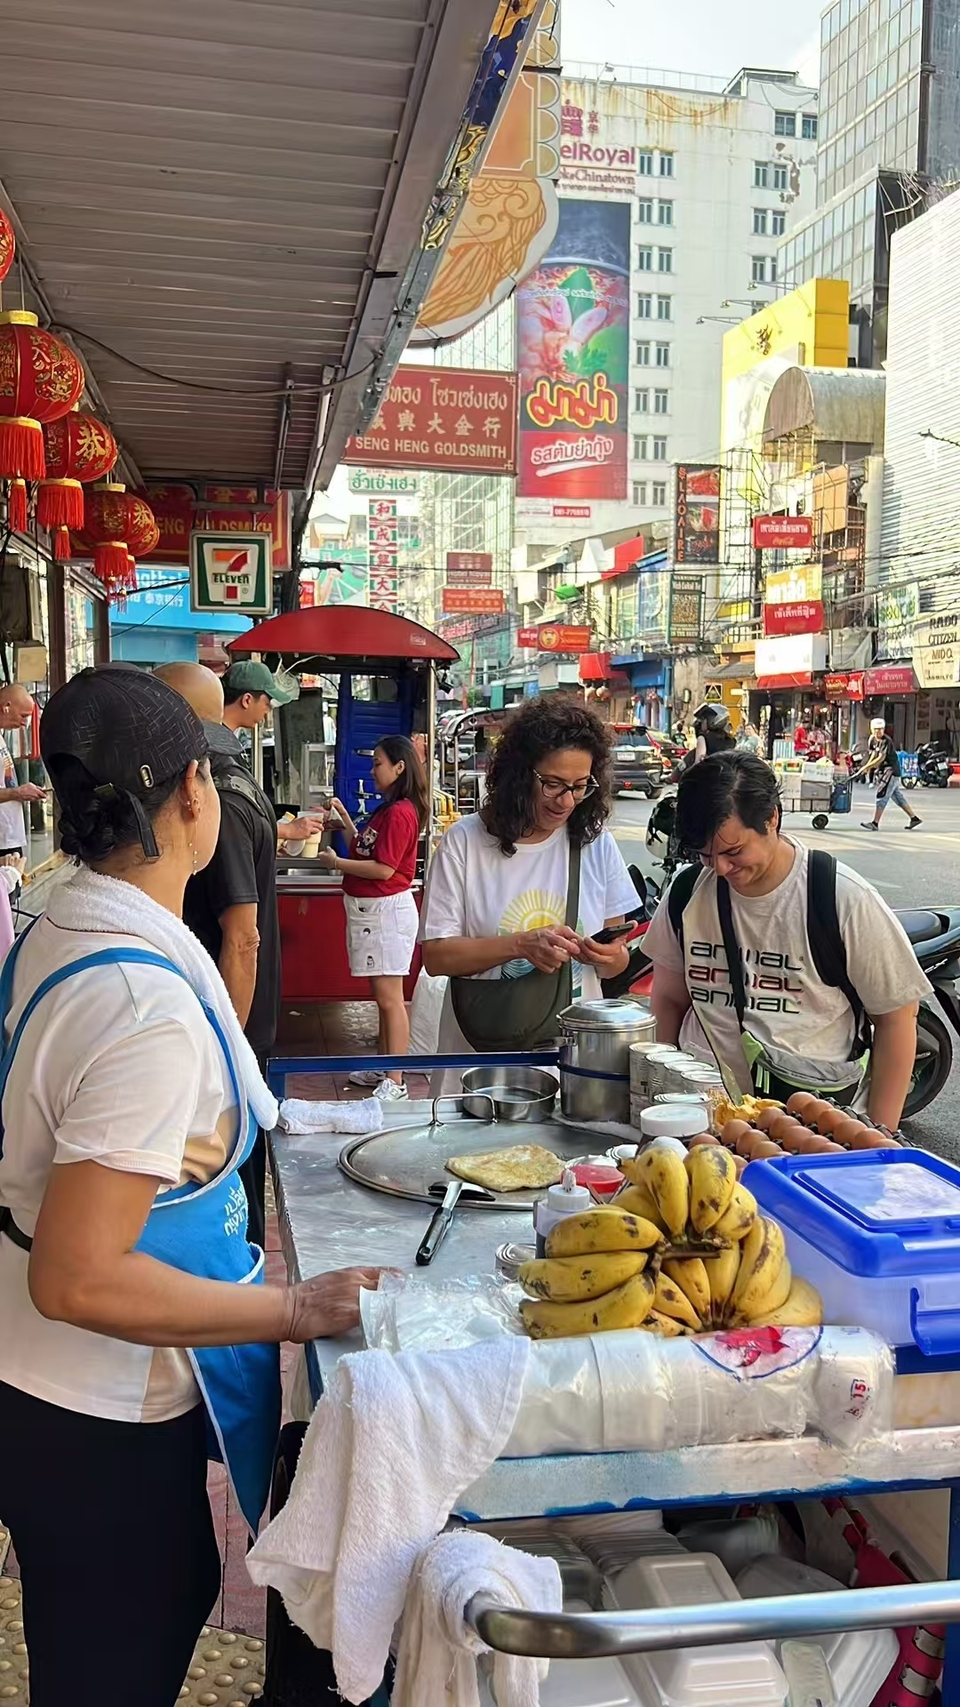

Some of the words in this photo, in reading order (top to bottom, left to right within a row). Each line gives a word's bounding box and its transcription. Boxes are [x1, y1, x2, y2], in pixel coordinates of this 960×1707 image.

[527, 372, 618, 428] มาม่า
[355, 437, 390, 451] SENG
[395, 439, 430, 454] HENG
[434, 441, 507, 459] GOLDSMITH
[531, 434, 614, 465] รสต้มยำกุ้ง
[929, 614, 958, 630] RADO
[928, 632, 957, 646] CITIZEN
